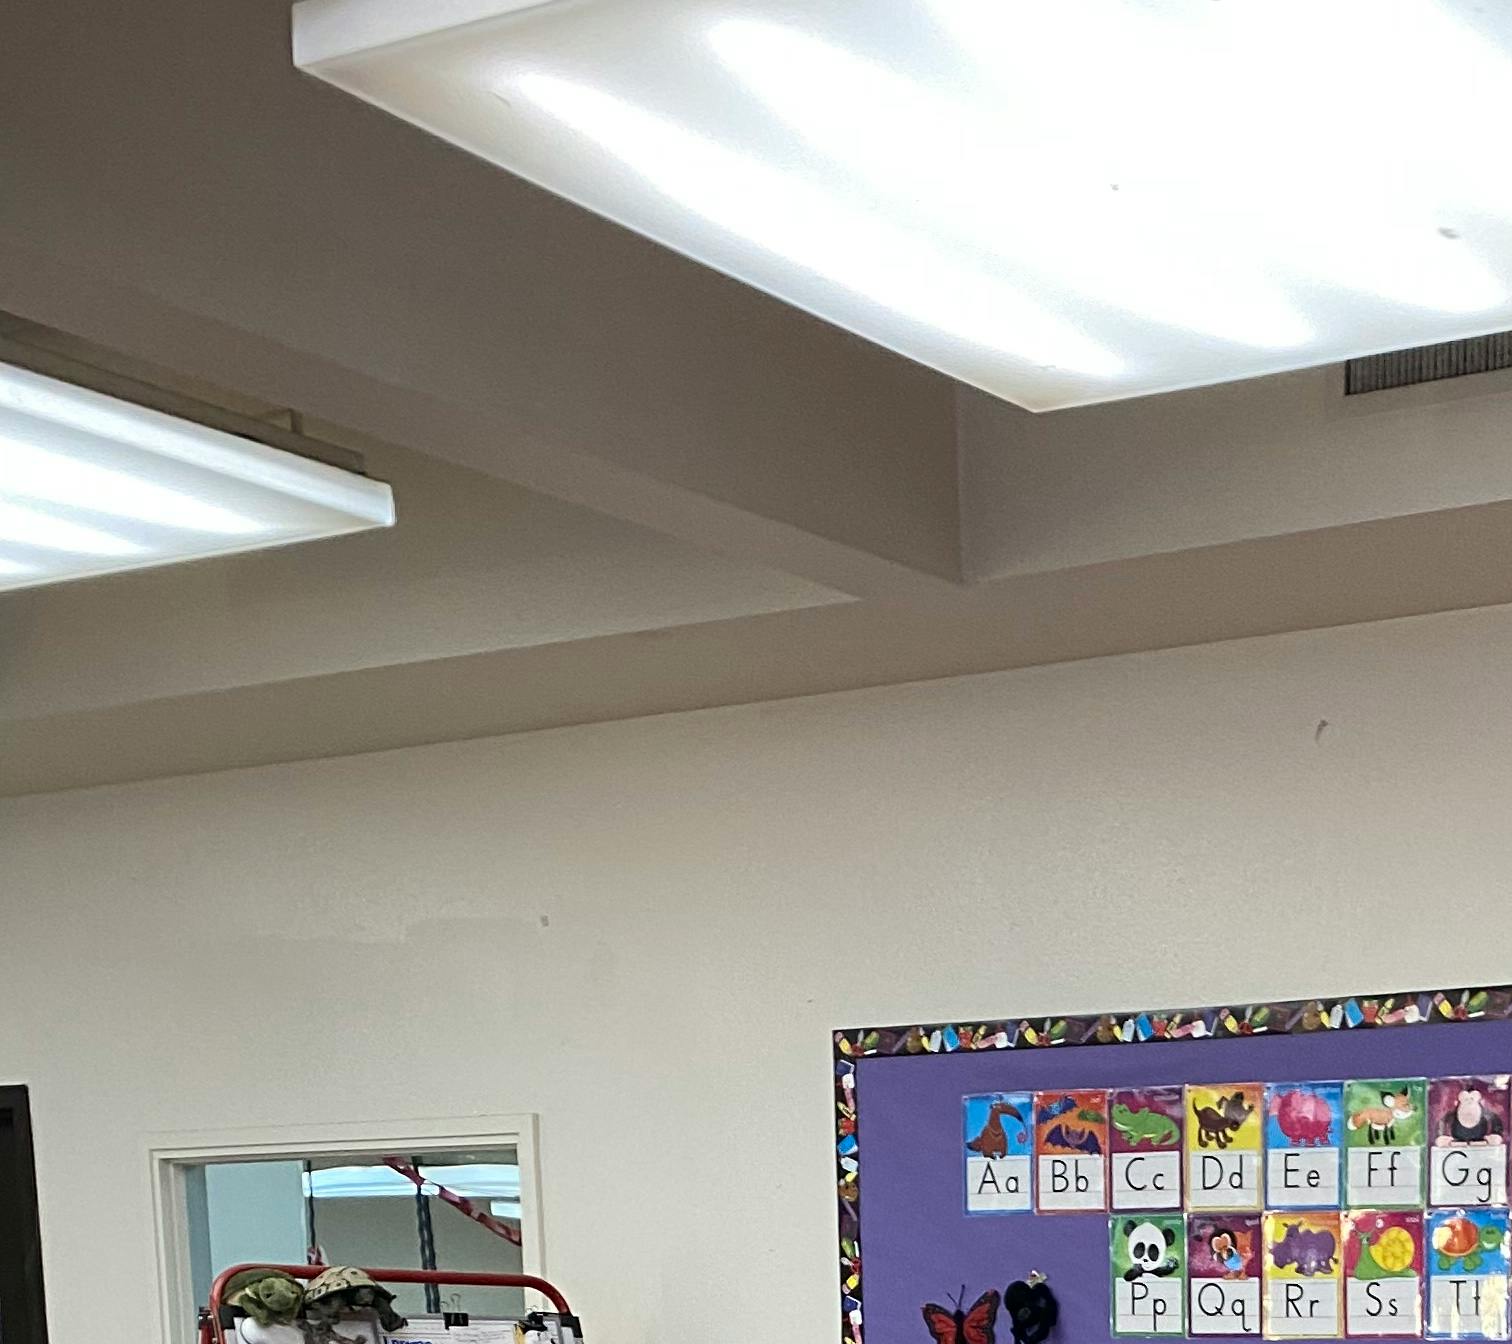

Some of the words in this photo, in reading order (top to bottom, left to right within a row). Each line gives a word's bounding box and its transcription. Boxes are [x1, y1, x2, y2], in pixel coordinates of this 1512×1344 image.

[977, 1162, 1020, 1194] Aa
[1051, 1159, 1089, 1193] Bb
[1125, 1157, 1165, 1191] Cc
[1201, 1156, 1244, 1190] Dd
[1283, 1153, 1321, 1189] Ee
[1366, 1151, 1401, 1187] Ff
[1441, 1150, 1492, 1203] Gg
[1130, 1282, 1168, 1333] Pp
[1198, 1283, 1252, 1332] Qq
[1285, 1283, 1320, 1318] Rr
[1365, 1281, 1399, 1317] Ss
